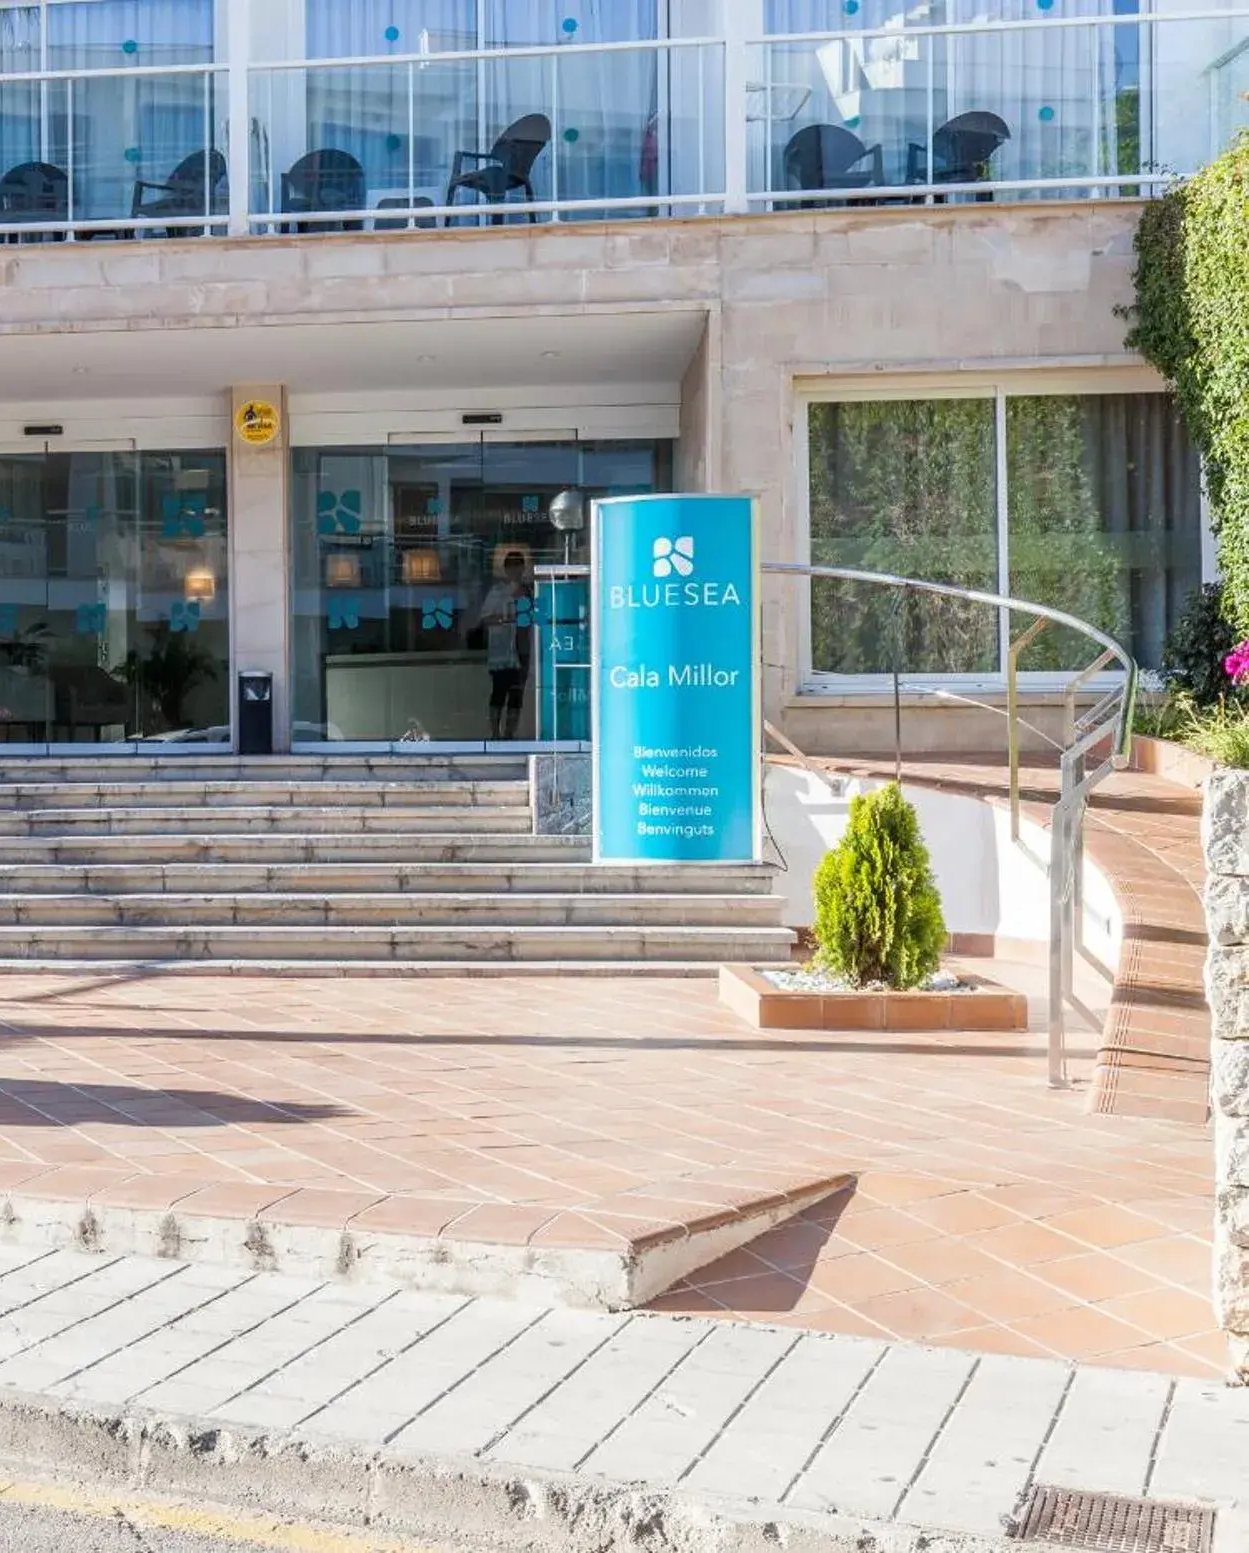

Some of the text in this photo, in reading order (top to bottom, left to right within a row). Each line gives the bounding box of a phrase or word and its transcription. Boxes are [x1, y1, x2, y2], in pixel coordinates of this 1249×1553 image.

[610, 583, 740, 608] BLUESEA
[610, 663, 740, 688] Cala Millor
[633, 745, 719, 758] Bienvenidos
[641, 765, 708, 777] Welcome
[632, 784, 719, 796] Willkommen
[639, 803, 712, 816] Bienvenue
[637, 822, 715, 837] Benvinguts
